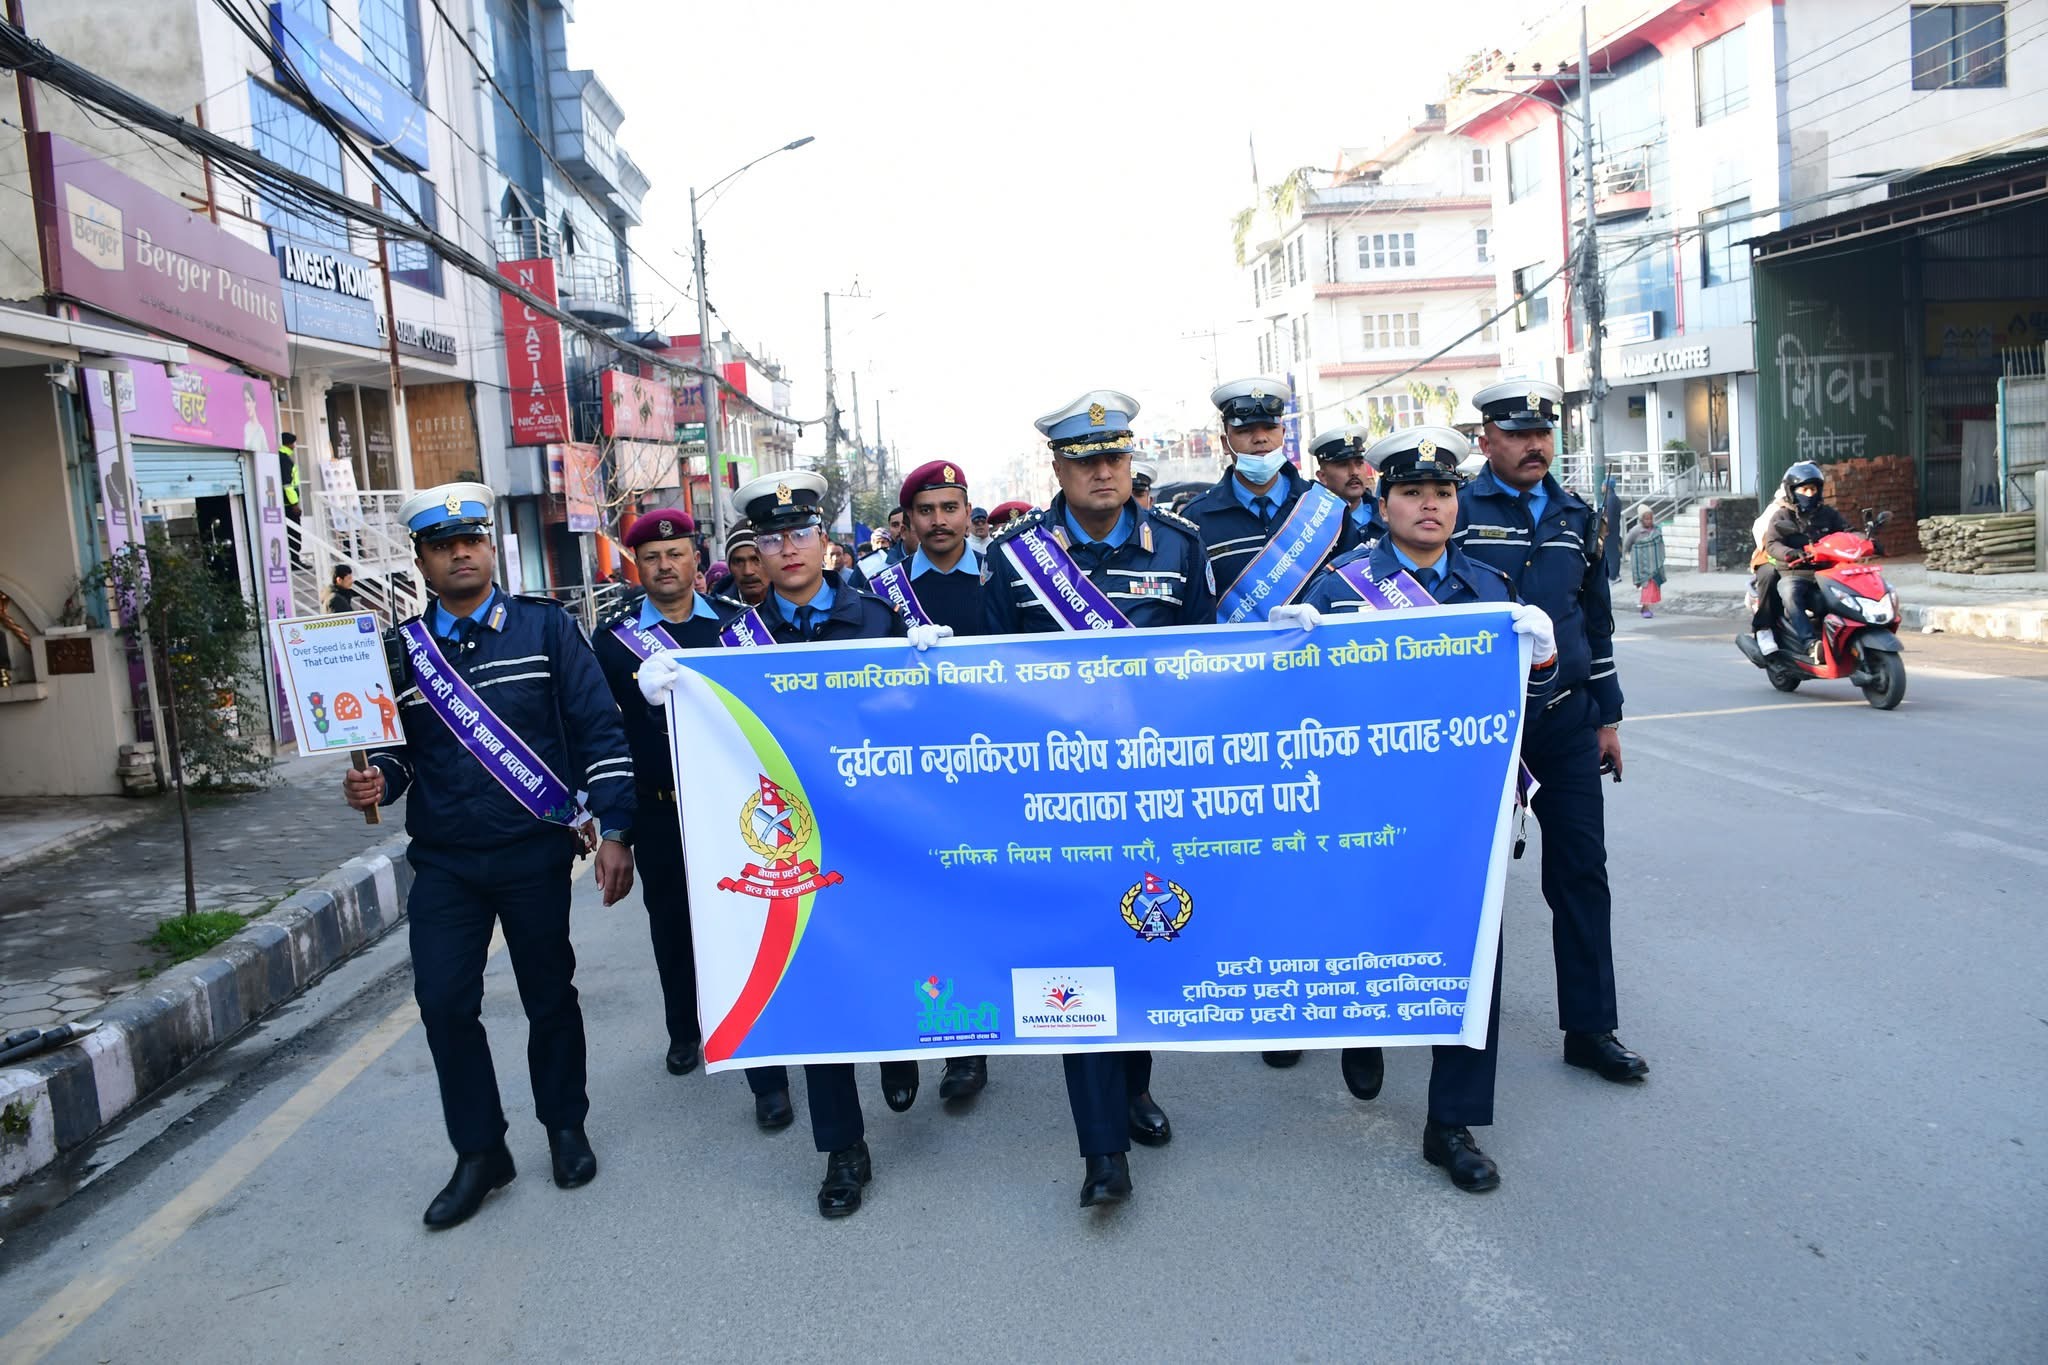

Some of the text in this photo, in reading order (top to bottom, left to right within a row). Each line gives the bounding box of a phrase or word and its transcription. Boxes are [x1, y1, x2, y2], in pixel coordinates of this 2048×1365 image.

[74, 214, 119, 256] Berger
[136, 227, 212, 292] Berger
[218, 268, 278, 324] Paints
[1052, 571, 1089, 613] चालक
[292, 647, 311, 657] Over
[313, 643, 338, 656] Speed
[339, 641, 347, 650] is
[354, 638, 375, 648] Knife
[304, 651, 370, 668] That Cut the Life
[825, 663, 930, 690] नागरिकको
[1015, 661, 1071, 683] सडक
[1077, 655, 1146, 685] दुर्घटना
[1153, 649, 1266, 680] न्यूनिकरण
[1272, 644, 1320, 672] हामी
[413, 650, 437, 680] सेवन
[431, 674, 453, 700] गरी
[447, 694, 479, 728] सवारी
[472, 722, 505, 755] साधन
[1047, 730, 1108, 774] विशेष
[1116, 727, 1214, 769] अभियान
[1222, 732, 1270, 766] तथा
[1276, 717, 1361, 770] ट्राफिक
[1023, 792, 1128, 823] भव्यताका
[1135, 788, 1184, 822] साथ
[1192, 784, 1265, 820] सफल
[1006, 842, 1053, 865] नियम
[1061, 845, 1113, 864] पालना
[1172, 837, 1262, 866] दुर्घटनाबाट
[1316, 835, 1329, 852] र
[1216, 956, 1263, 978] प्रहरी
[1268, 958, 1319, 976] प्रभाग
[1181, 980, 1248, 1003] ट्राफिक
[1252, 979, 1299, 1000] प्रहरी
[1022, 1013, 1107, 1024] SAMYAK SCHOOL
[1147, 1004, 1245, 1028] सामुदायिक
[1250, 1003, 1296, 1024] प्रहरी
[1302, 1003, 1337, 1021] सेवा
